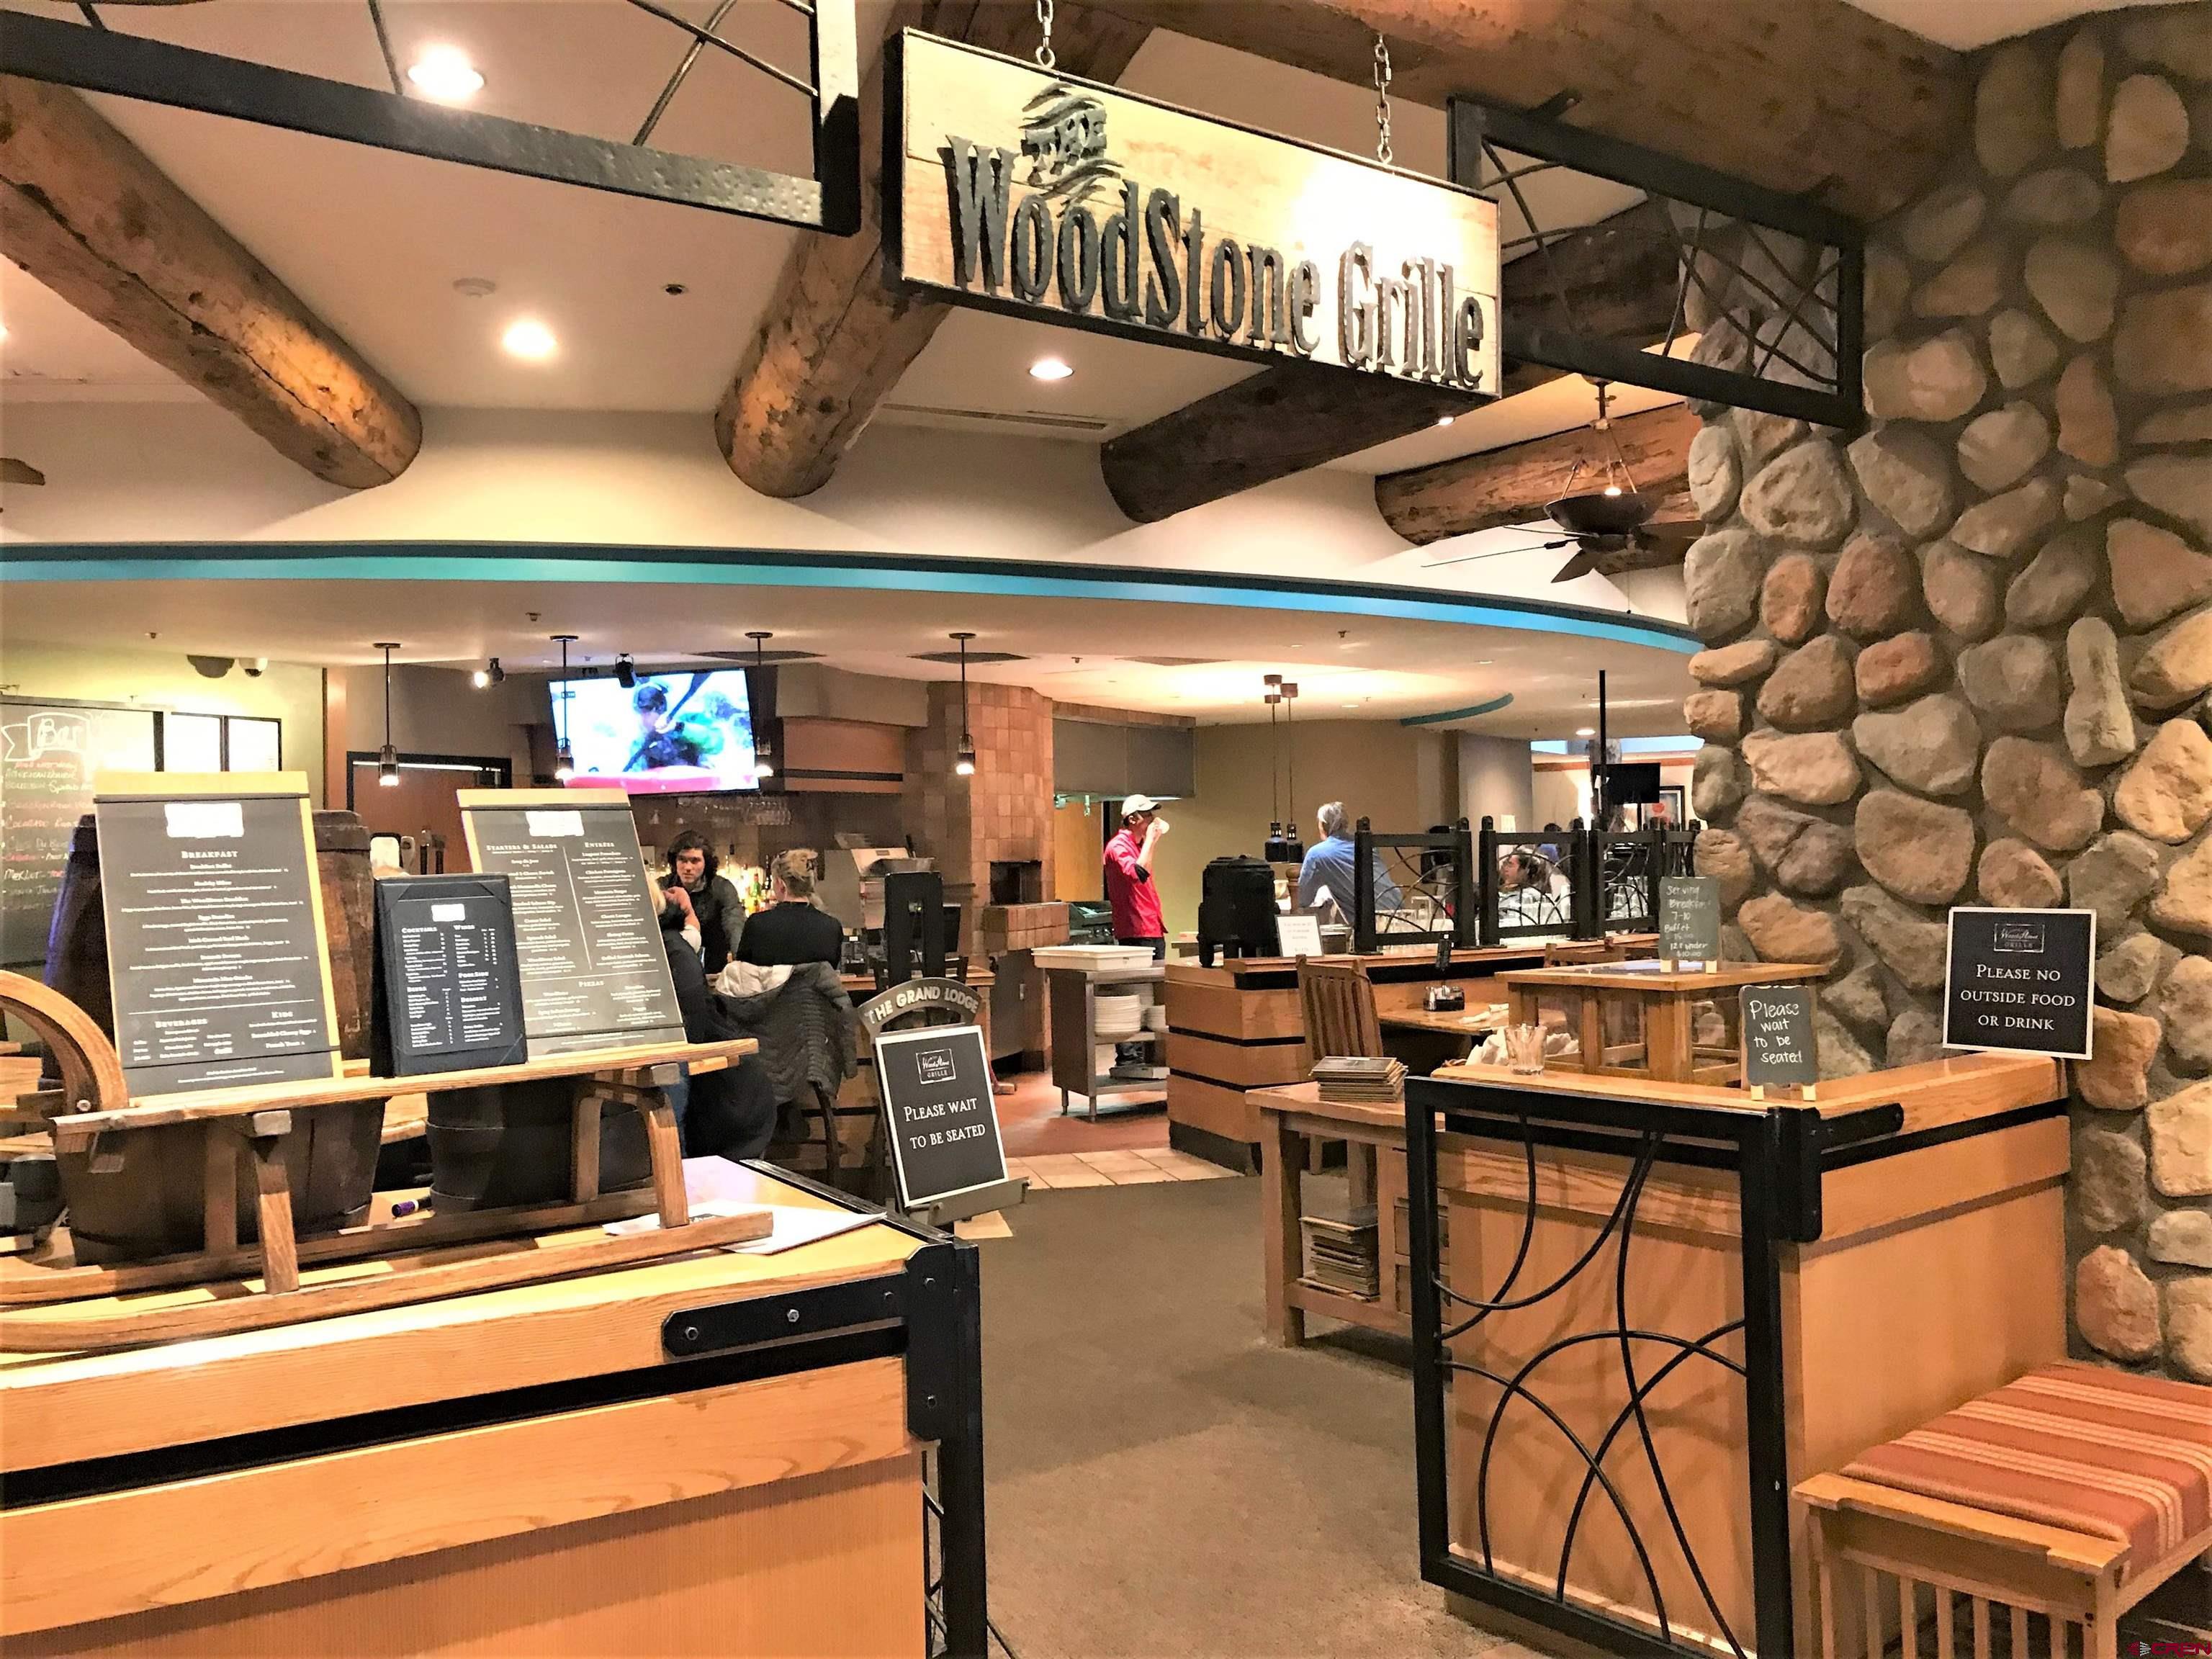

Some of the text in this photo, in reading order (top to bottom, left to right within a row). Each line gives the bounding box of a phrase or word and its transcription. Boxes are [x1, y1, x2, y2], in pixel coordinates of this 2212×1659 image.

[938, 135, 1485, 390] WoodStone Grille
[181, 850, 238, 859] BREAKFAST
[1976, 964, 2062, 981] PLEASE NO
[865, 986, 979, 1024] THE GRAND LODGE
[1960, 990, 2076, 1007] OUTSIDE FOOD
[1749, 1000, 1799, 1020] Please
[1761, 1018, 1790, 1033] wait
[1978, 1015, 2055, 1030] OR DRINK
[1753, 1035, 1791, 1048] to be
[1761, 1050, 1802, 1065] seated
[904, 1098, 977, 1122] PLEASE WAIT
[909, 1124, 986, 1149] TO BE SEATED
